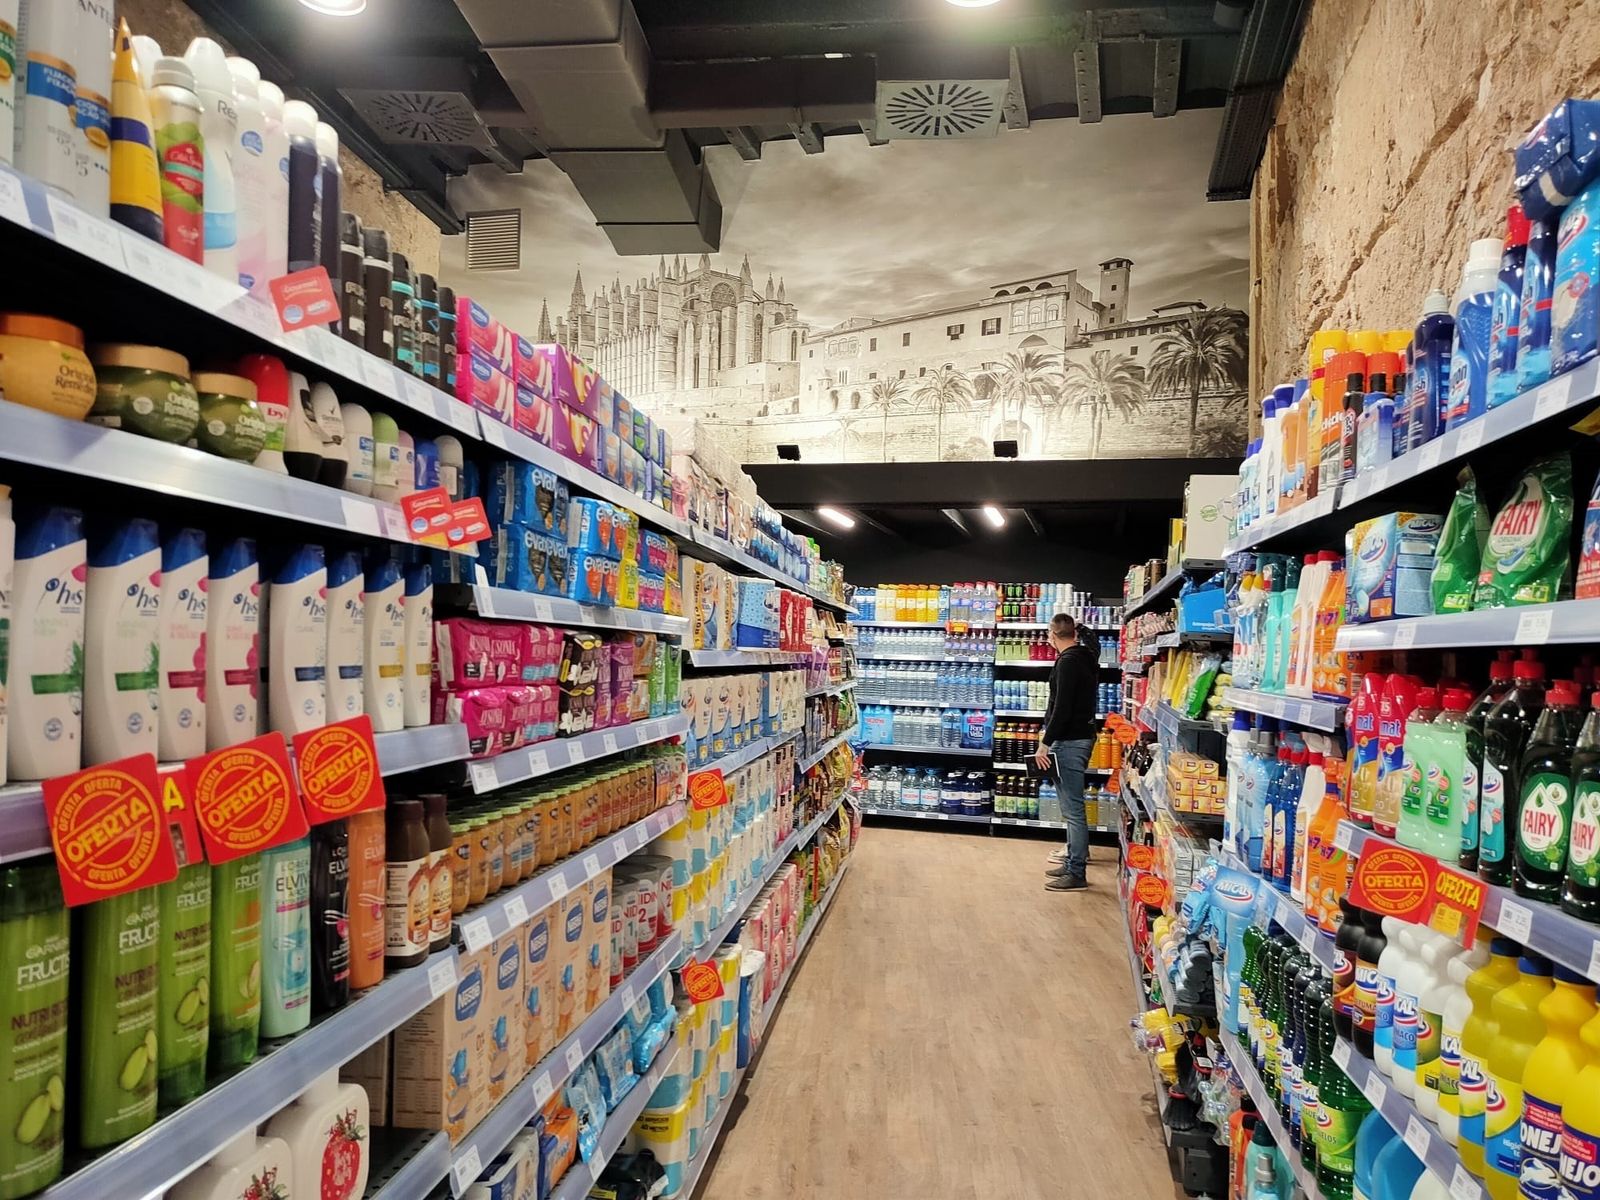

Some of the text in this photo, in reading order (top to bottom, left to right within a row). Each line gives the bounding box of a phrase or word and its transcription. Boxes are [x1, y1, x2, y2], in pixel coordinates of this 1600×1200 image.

[1493, 500, 1542, 535] FAIRY
[307, 746, 366, 794] OFERTA
[207, 769, 280, 828] OFERTA
[66, 797, 151, 863] OFERTA
[1523, 809, 1556, 838] FAIRY
[1217, 880, 1250, 896] MICAL
[1364, 874, 1424, 888] OFERTA
[1435, 871, 1481, 910] OFERTA
